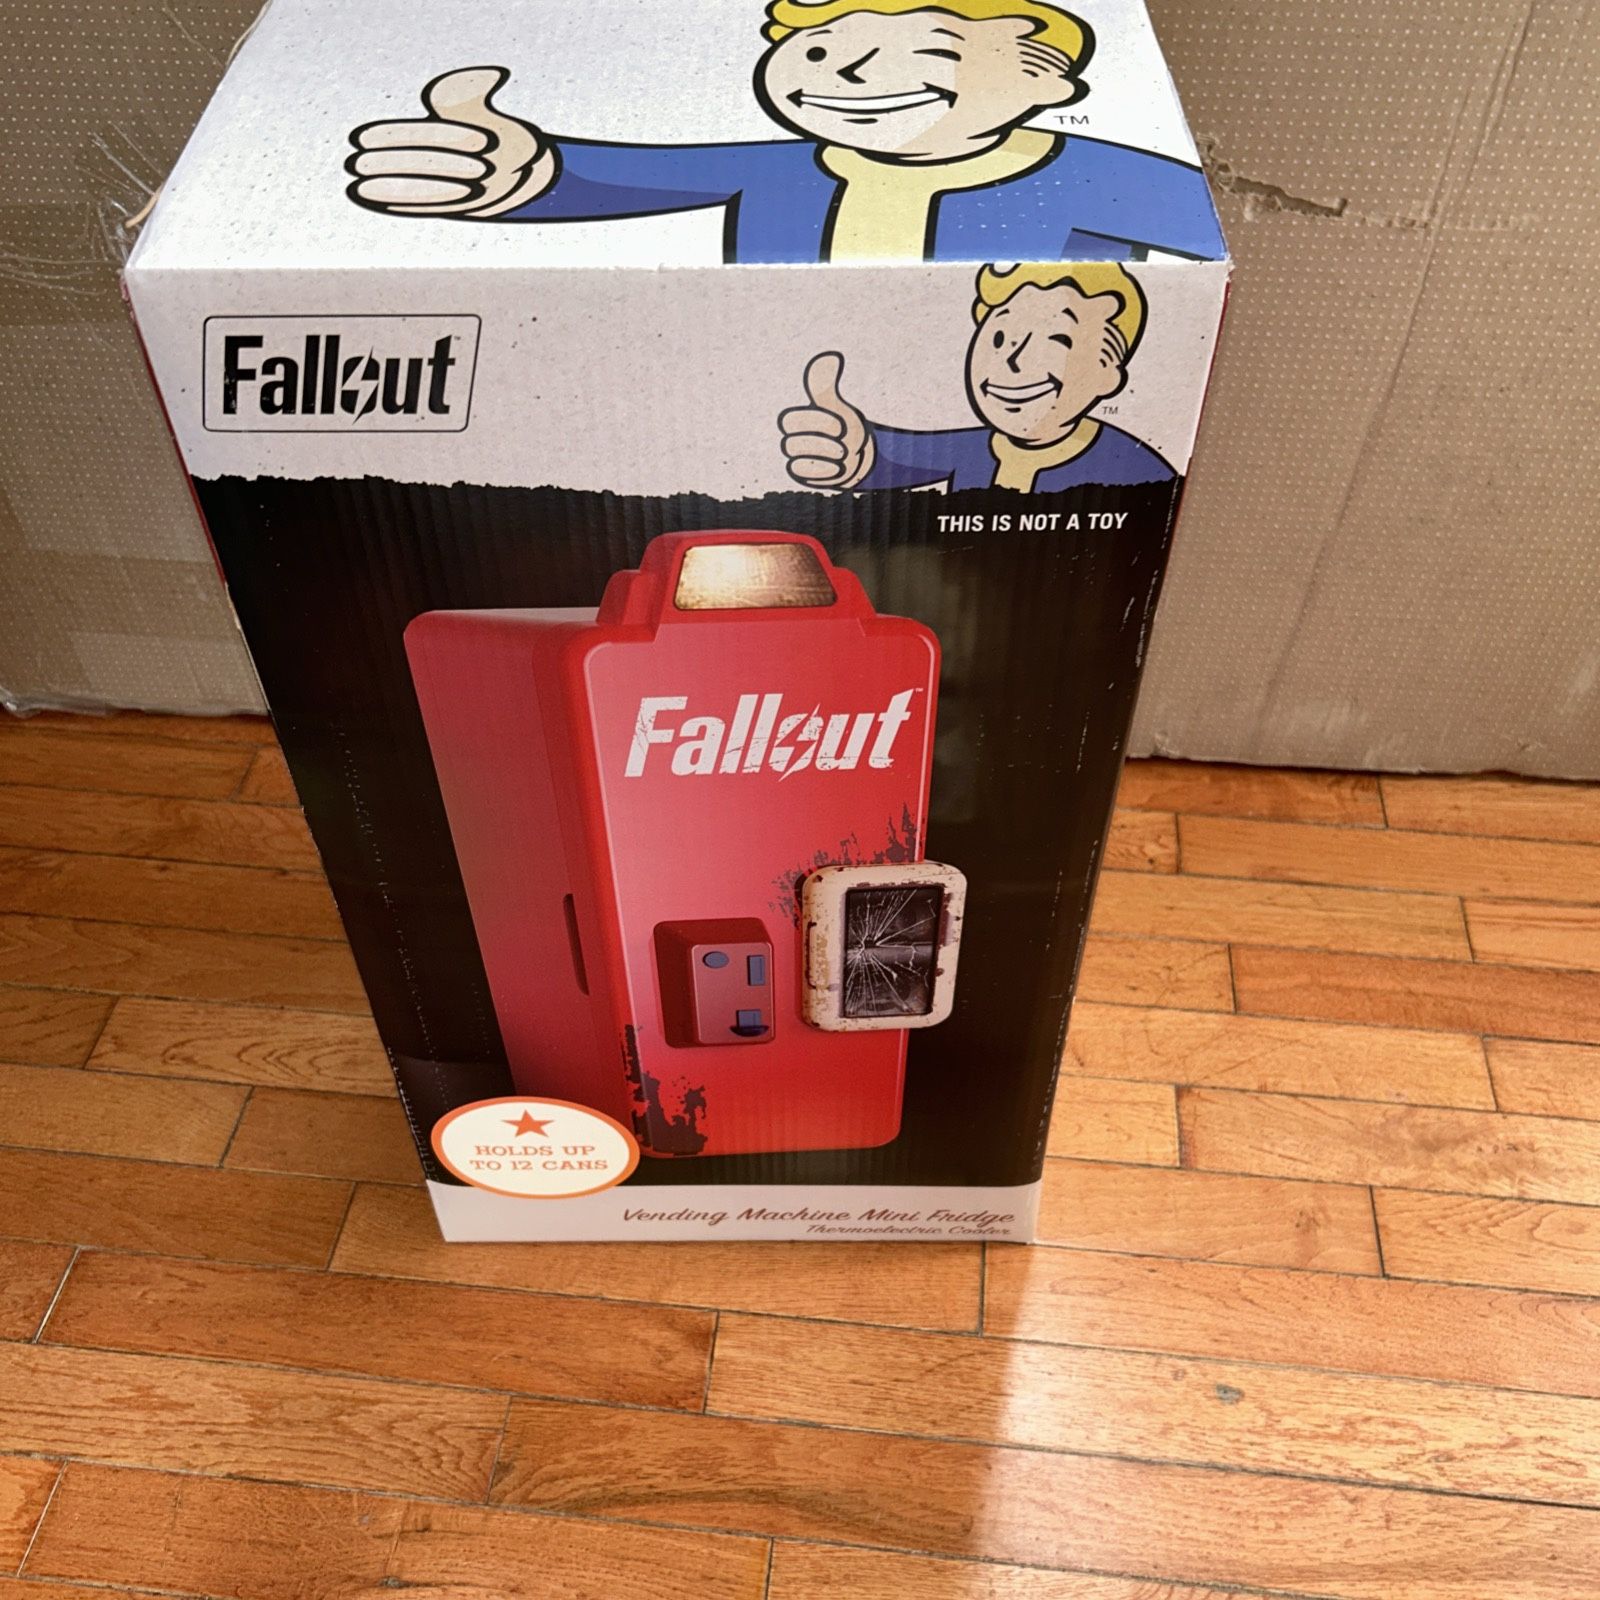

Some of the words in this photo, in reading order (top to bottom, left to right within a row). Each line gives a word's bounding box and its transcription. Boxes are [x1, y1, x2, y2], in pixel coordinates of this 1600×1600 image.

[1053, 115, 1090, 125] TM
[223, 334, 456, 425] Fallout
[937, 514, 985, 532] THIS
[992, 513, 1011, 532] IS
[1019, 513, 1061, 531] NOT
[1066, 513, 1080, 531] A
[1088, 512, 1128, 530] TOY
[624, 688, 914, 782] Fallout
[474, 1145, 553, 1156] HOLDS
[562, 1145, 596, 1156] UP
[469, 1160, 502, 1171] TO
[511, 1160, 533, 1171] 12
[542, 1160, 608, 1171] CANS
[623, 1207, 729, 1226] Vending
[736, 1207, 850, 1221] Machine
[858, 1208, 920, 1222] Mini
[926, 1209, 1016, 1227] Fridge
[807, 1224, 942, 1234] Thermoelectric
[947, 1225, 1011, 1235] Cooler
